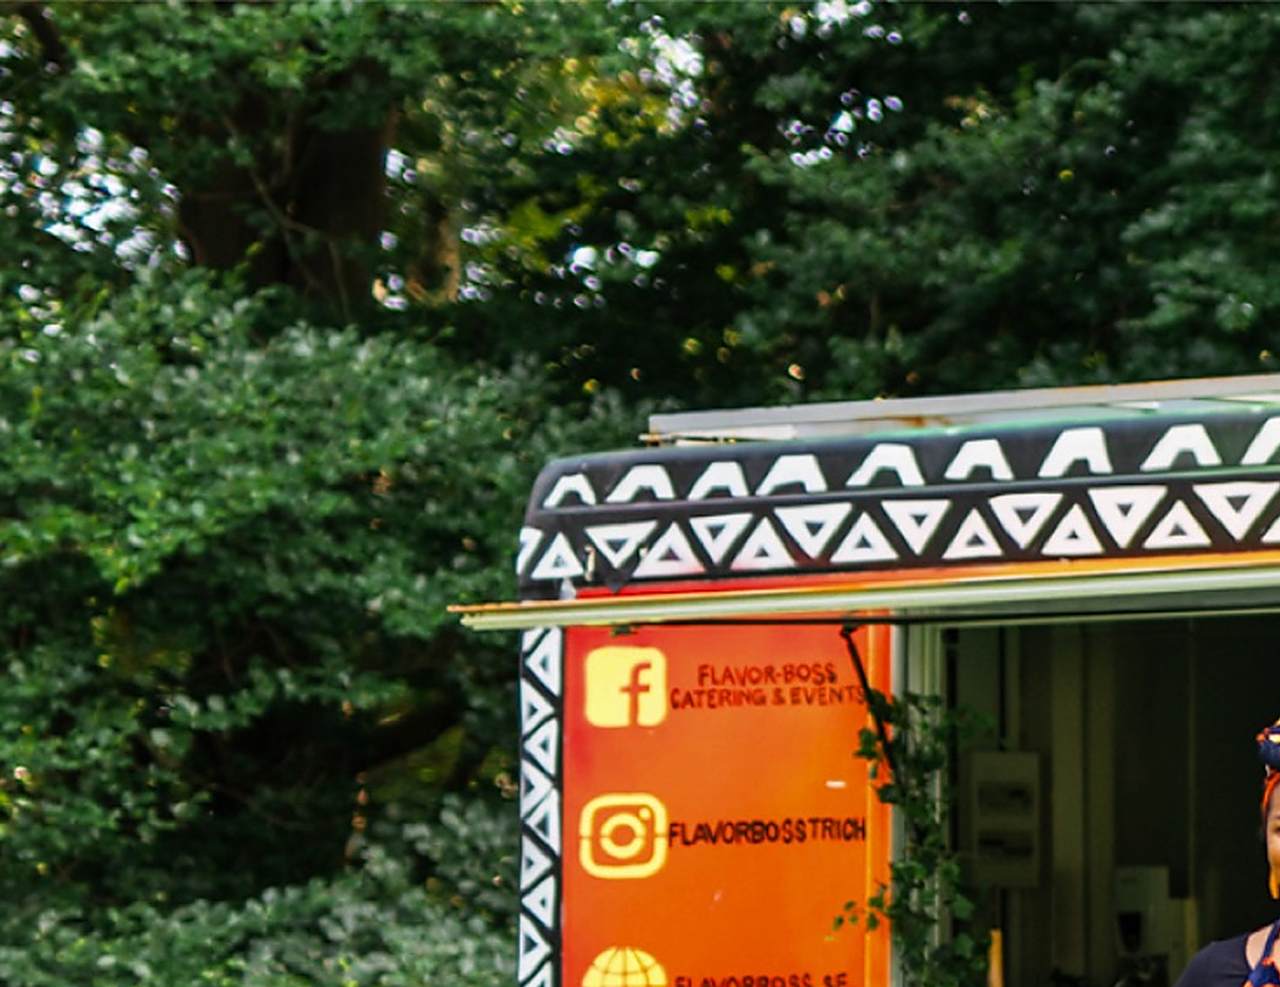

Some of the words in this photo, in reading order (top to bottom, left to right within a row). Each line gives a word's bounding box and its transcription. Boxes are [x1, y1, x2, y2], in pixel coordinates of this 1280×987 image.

[698, 662, 838, 688] FLAVOR-BOSS
[671, 687, 769, 709] CATERING
[773, 686, 787, 706] &
[791, 683, 868, 705] EVENTS
